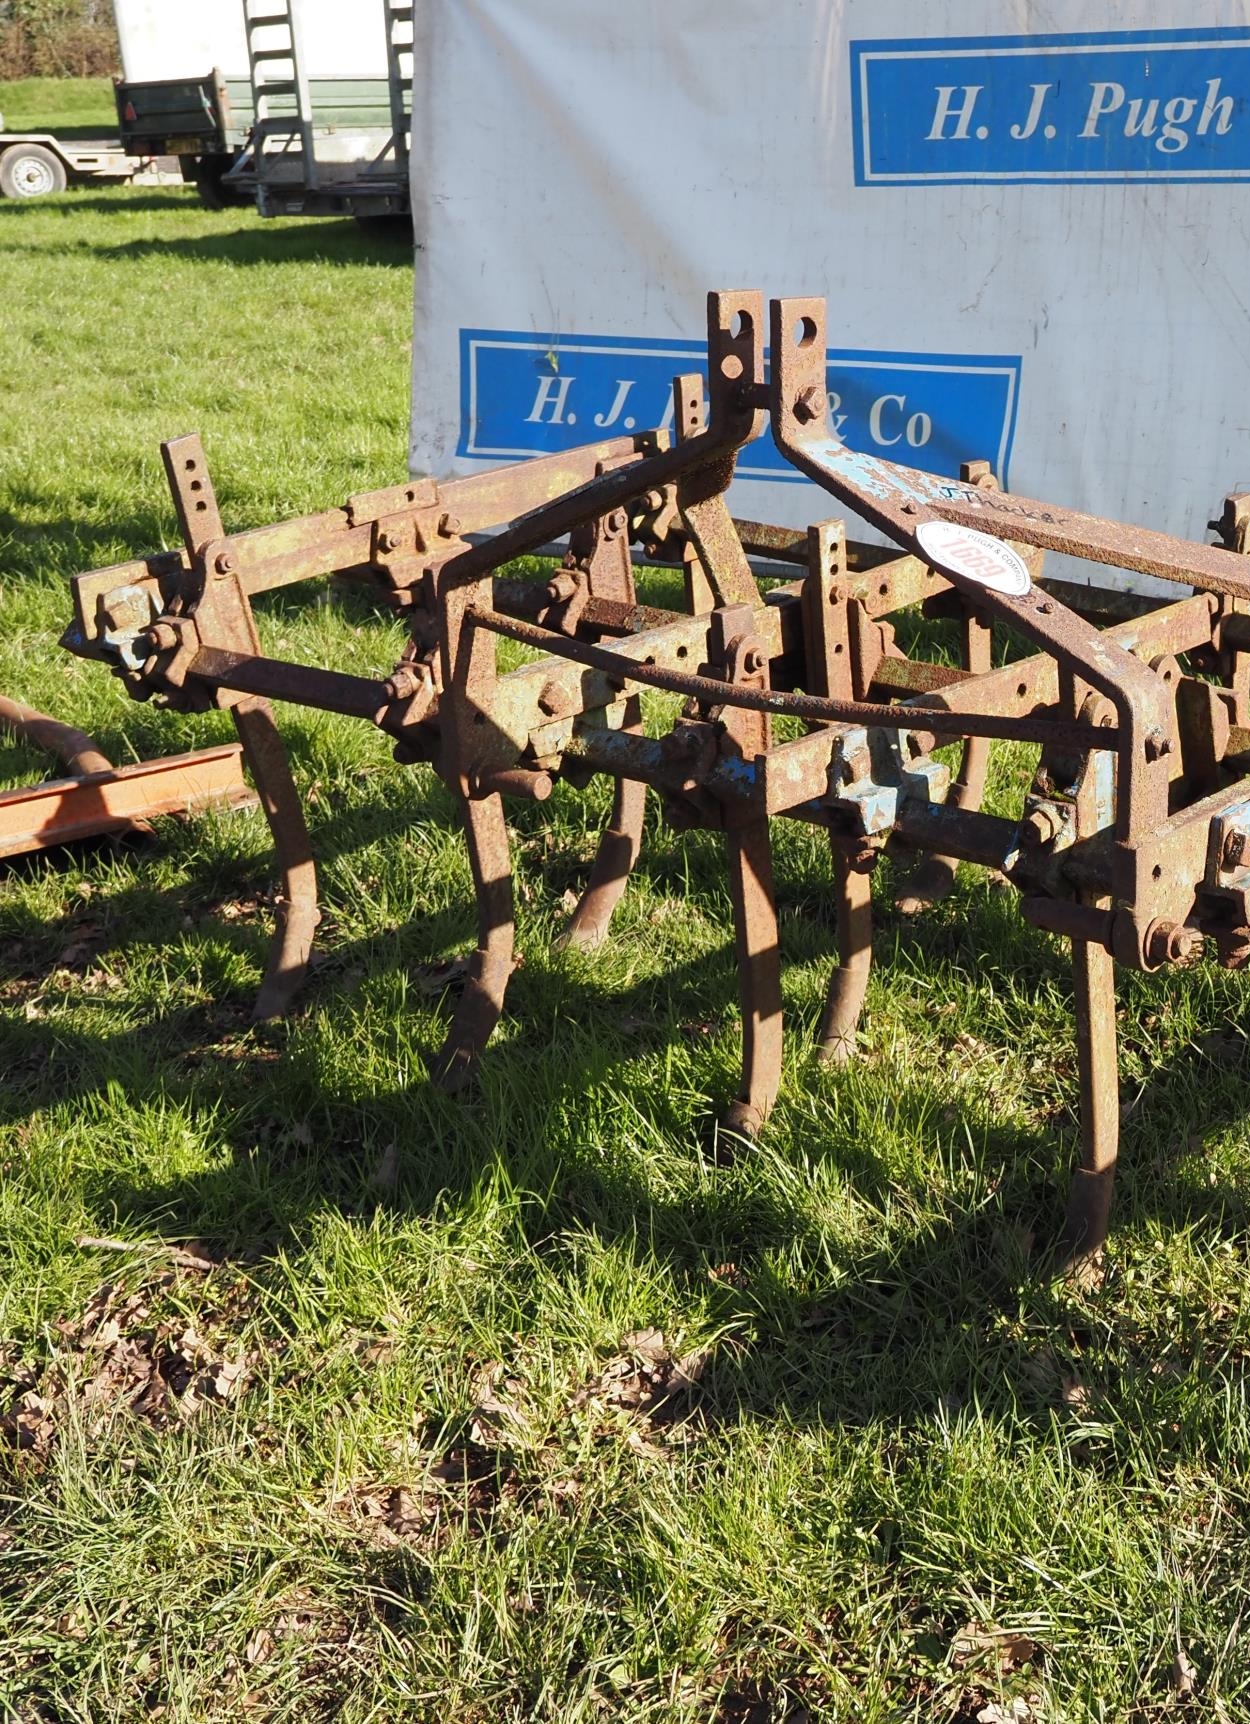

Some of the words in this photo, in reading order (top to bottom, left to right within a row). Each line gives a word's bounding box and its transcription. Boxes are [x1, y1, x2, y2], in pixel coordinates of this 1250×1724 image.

[924, 86, 989, 140] H.
[1010, 84, 1056, 140] J.
[1079, 78, 1234, 153] Pugh
[525, 376, 577, 425] H.
[594, 380, 636, 429] J.
[869, 394, 932, 447] Co
[939, 538, 1007, 577] 1669
